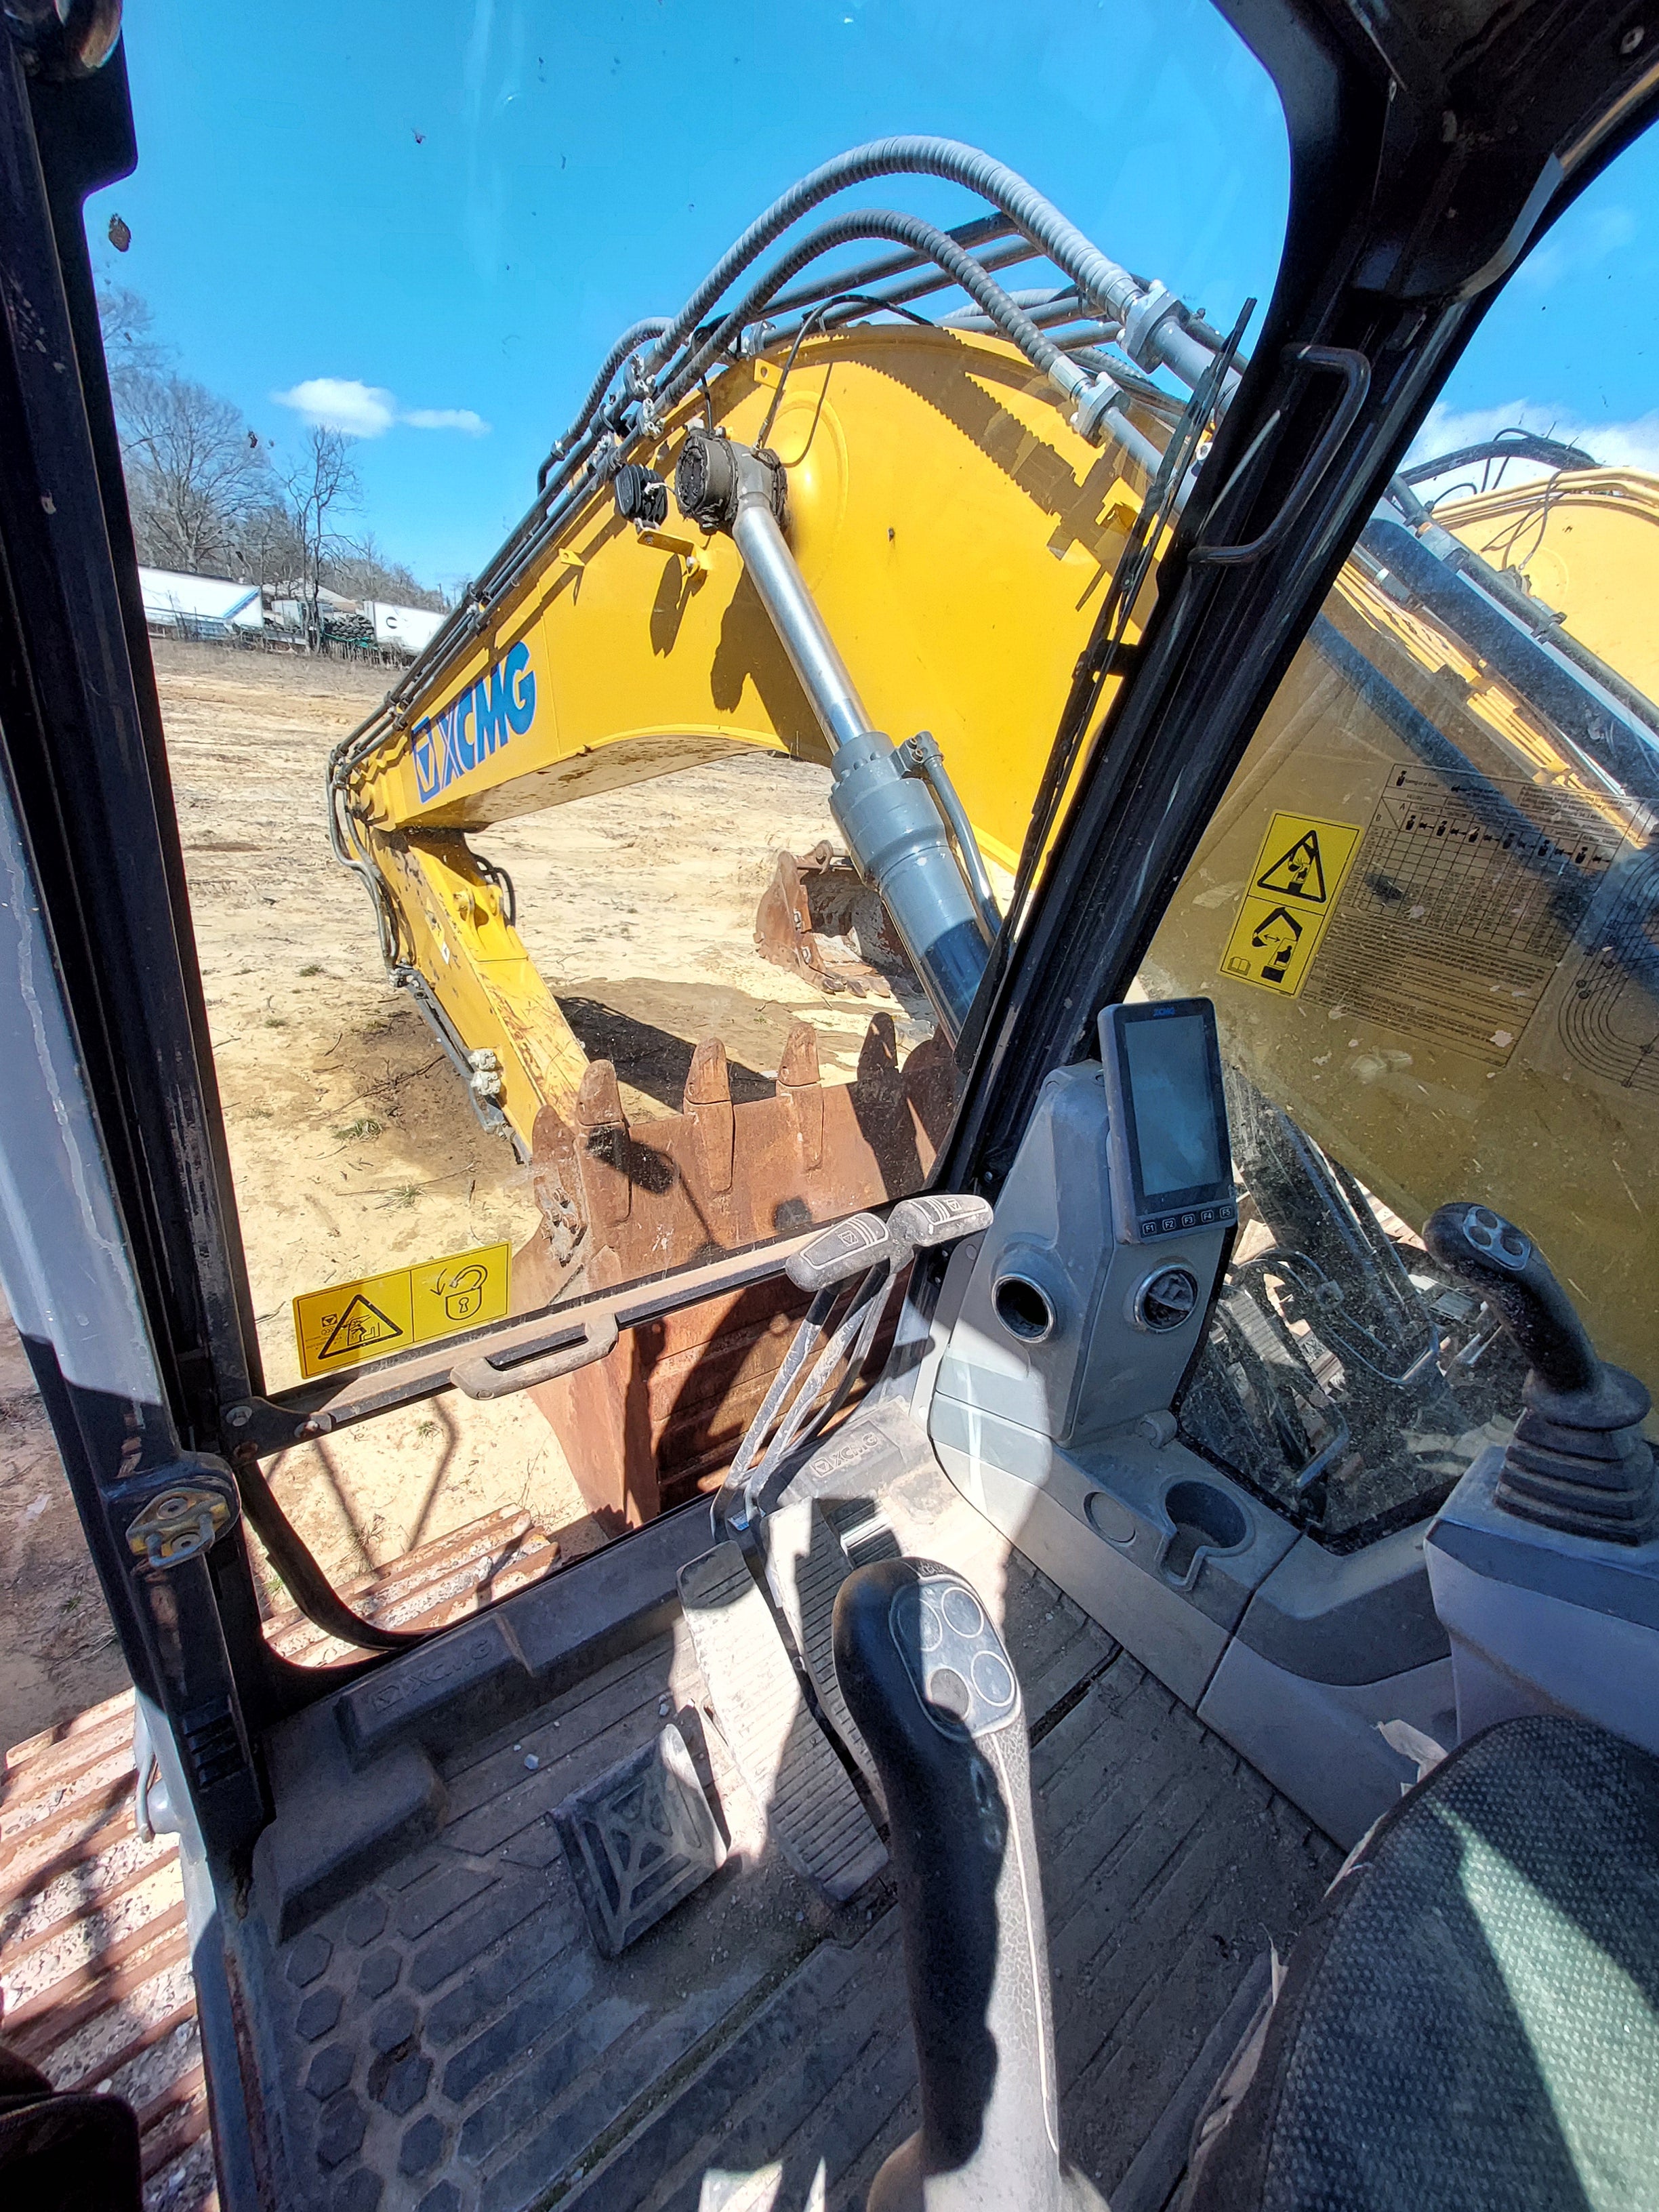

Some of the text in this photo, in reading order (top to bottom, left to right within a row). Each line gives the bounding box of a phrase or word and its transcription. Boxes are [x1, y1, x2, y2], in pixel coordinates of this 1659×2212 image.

[436, 640, 537, 789] XCMG
[1145, 1208, 1231, 1233] F1 F2 F3 F4 F5
[832, 1433, 878, 1466] XCMG
